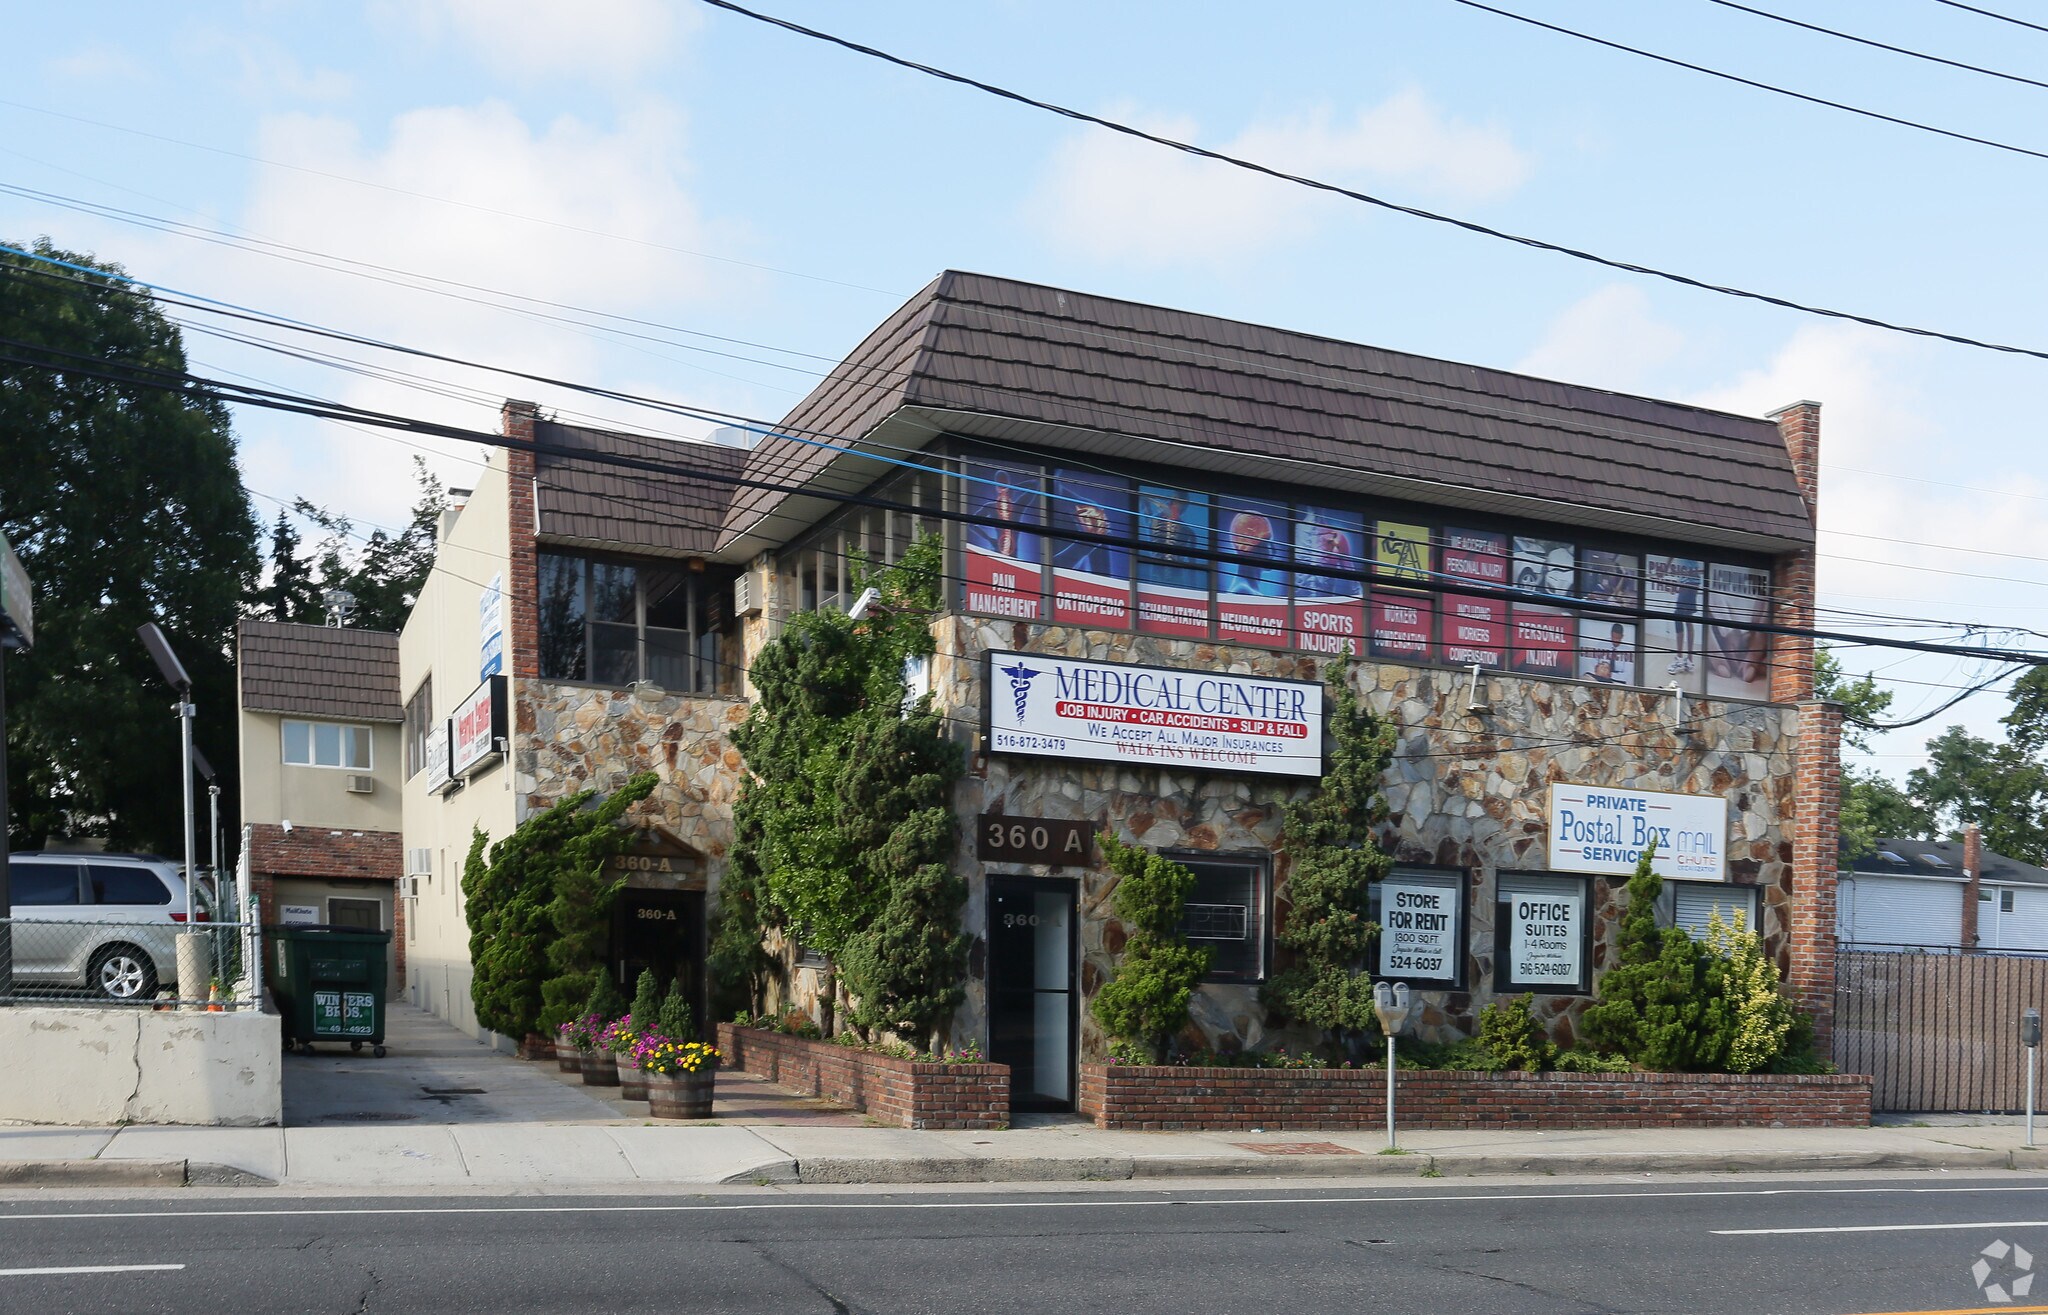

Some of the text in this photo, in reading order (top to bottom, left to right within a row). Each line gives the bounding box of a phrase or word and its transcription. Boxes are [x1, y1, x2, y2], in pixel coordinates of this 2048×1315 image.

[1447, 557, 1503, 578] PERSONAL INJURY
[992, 573, 1016, 593] PAIN
[969, 593, 1037, 619] MANAGEMENT
[1056, 591, 1125, 617] ORTHOPEDIC
[1457, 603, 1491, 620] INCLUDING
[1139, 602, 1208, 627] REHABILITATION
[1303, 610, 1353, 633] SPORTS
[1384, 604, 1417, 625] WORKERS
[1221, 612, 1284, 637] NEUROLOGY
[1457, 625, 1490, 642] WORKERS
[1518, 622, 1566, 643] PERSONAL
[1374, 630, 1427, 651] COMPENSATION
[1449, 647, 1498, 665] COMPENSATION
[1526, 650, 1559, 667] INJURY
[1054, 666, 1307, 722] MEDICAL CENTER
[1060, 703, 1303, 737] JOB INJURY CAR ACCIDENTS SLIP & FALL
[997, 734, 1066, 750] 516-872-3479
[1117, 741, 1257, 764] WALK-INS WELCOME
[1587, 794, 1646, 812] PRIVATE
[988, 823, 1083, 852] 360 A
[1559, 810, 1670, 848] Postal Box
[615, 855, 672, 872] 360-A
[1677, 855, 1716, 866] CHUTE
[1396, 892, 1440, 909] STORE
[638, 908, 676, 920] 360-A
[1519, 902, 1570, 921] OFFICE
[1389, 911, 1448, 931] FOR RENT
[1394, 932, 1415, 943] 1300
[1525, 924, 1567, 937] SUITES
[1524, 939, 1567, 950] 1-4 Rooms
[1390, 955, 1443, 971] 524-6037
[1520, 962, 1572, 975] 516-524-6037
[315, 994, 374, 1007] WINERS
[330, 1025, 371, 1033] 49-4923
